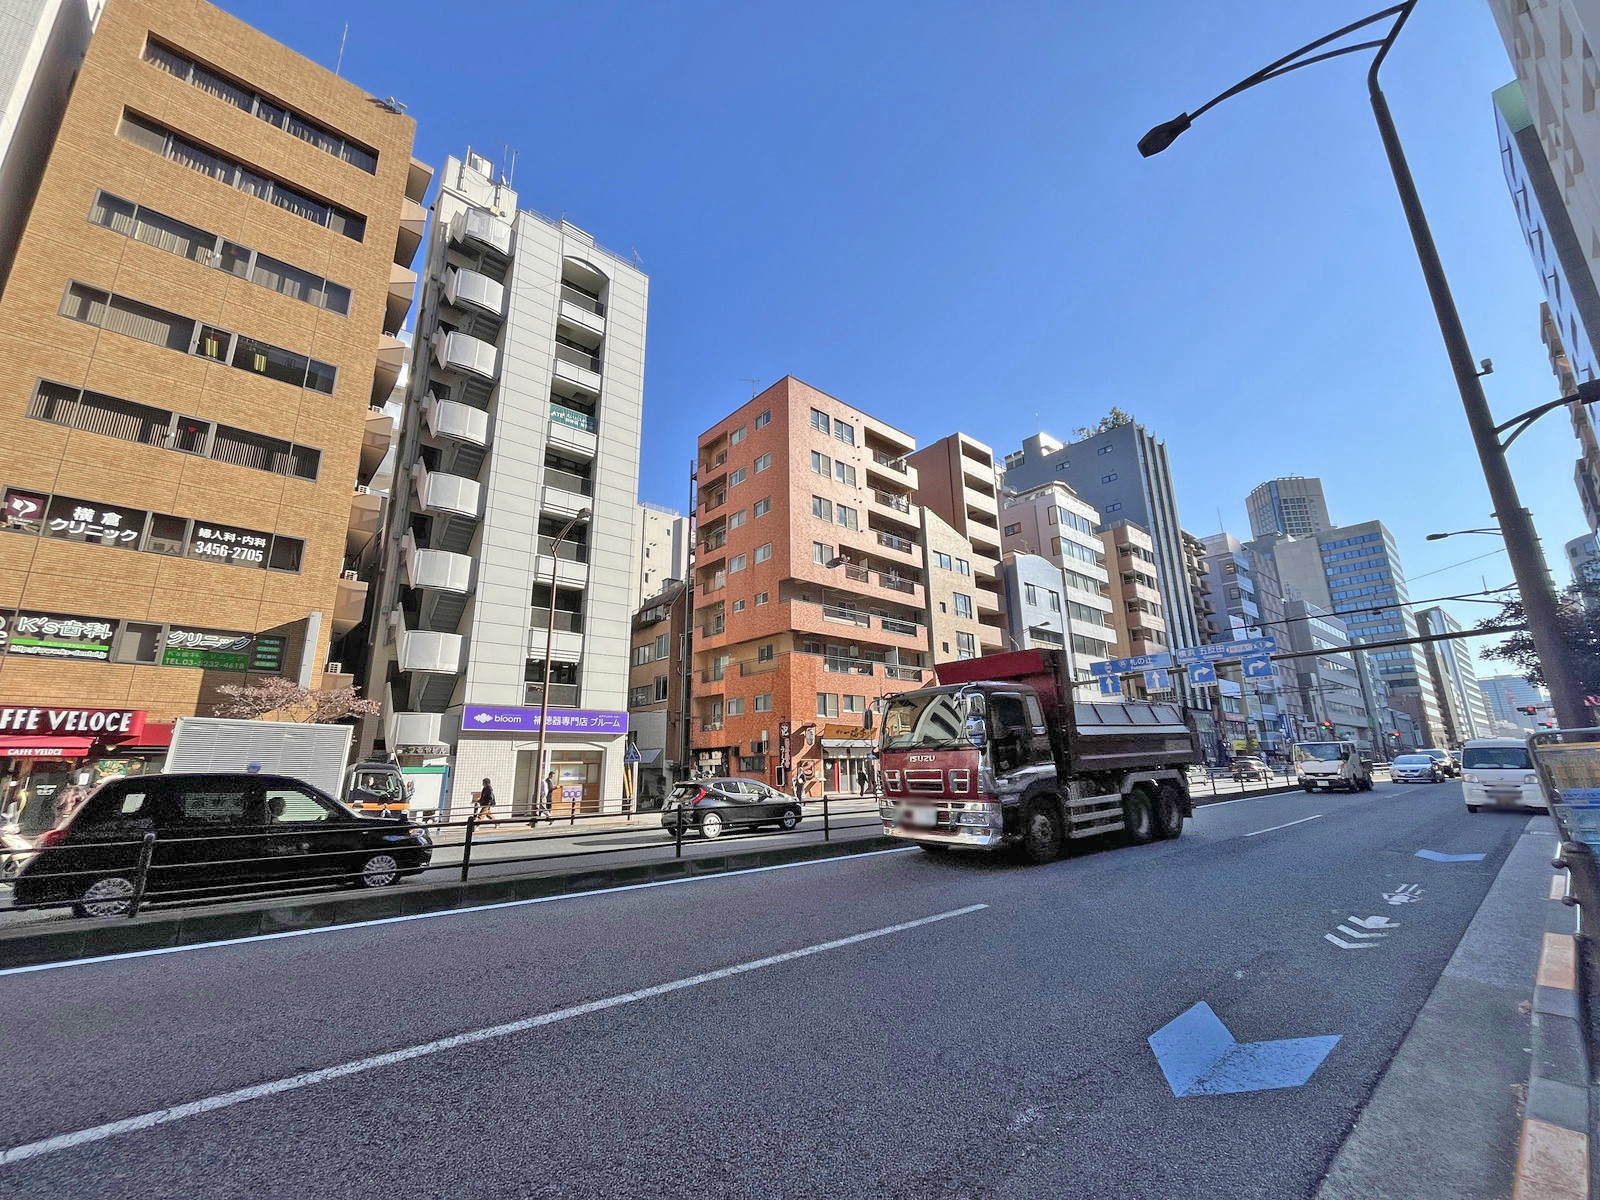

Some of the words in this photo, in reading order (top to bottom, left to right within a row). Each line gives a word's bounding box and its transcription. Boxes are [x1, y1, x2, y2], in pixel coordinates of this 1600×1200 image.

[73, 506, 123, 527] 横倉
[50, 518, 138, 542] クリニック
[198, 528, 267, 548] 婦人科・内科
[195, 541, 264, 563] 3456-2705
[18, 616, 113, 640] K's歯科
[167, 630, 251, 651] クリニック
[1199, 644, 1225, 655] 五反田
[1129, 656, 1153, 666] 札の辻
[48, 710, 133, 733] VELOCE
[494, 714, 522, 724] bloom
[590, 717, 621, 728] ブルーム
[34, 748, 63, 756] VELOCE
[909, 754, 936, 763] ISUZU
